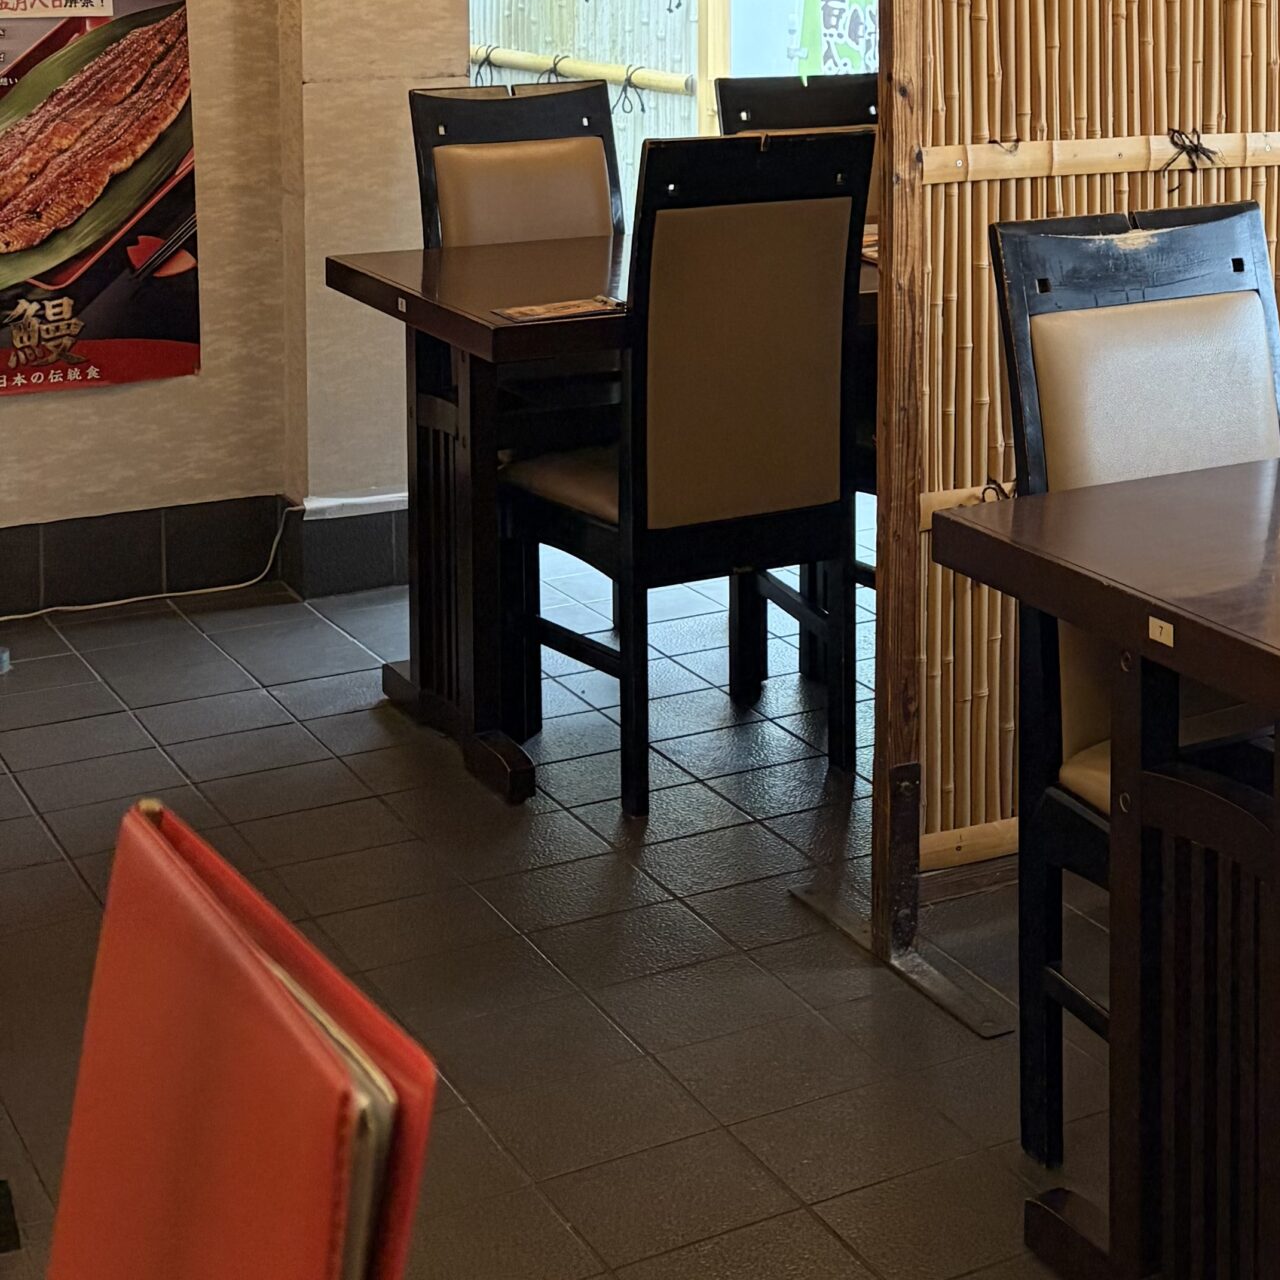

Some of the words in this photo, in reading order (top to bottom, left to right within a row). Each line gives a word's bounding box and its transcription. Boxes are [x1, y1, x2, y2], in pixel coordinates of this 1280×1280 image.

[3, 296, 89, 369] 鰻
[0, 365, 100, 387] 日本の伝統食
